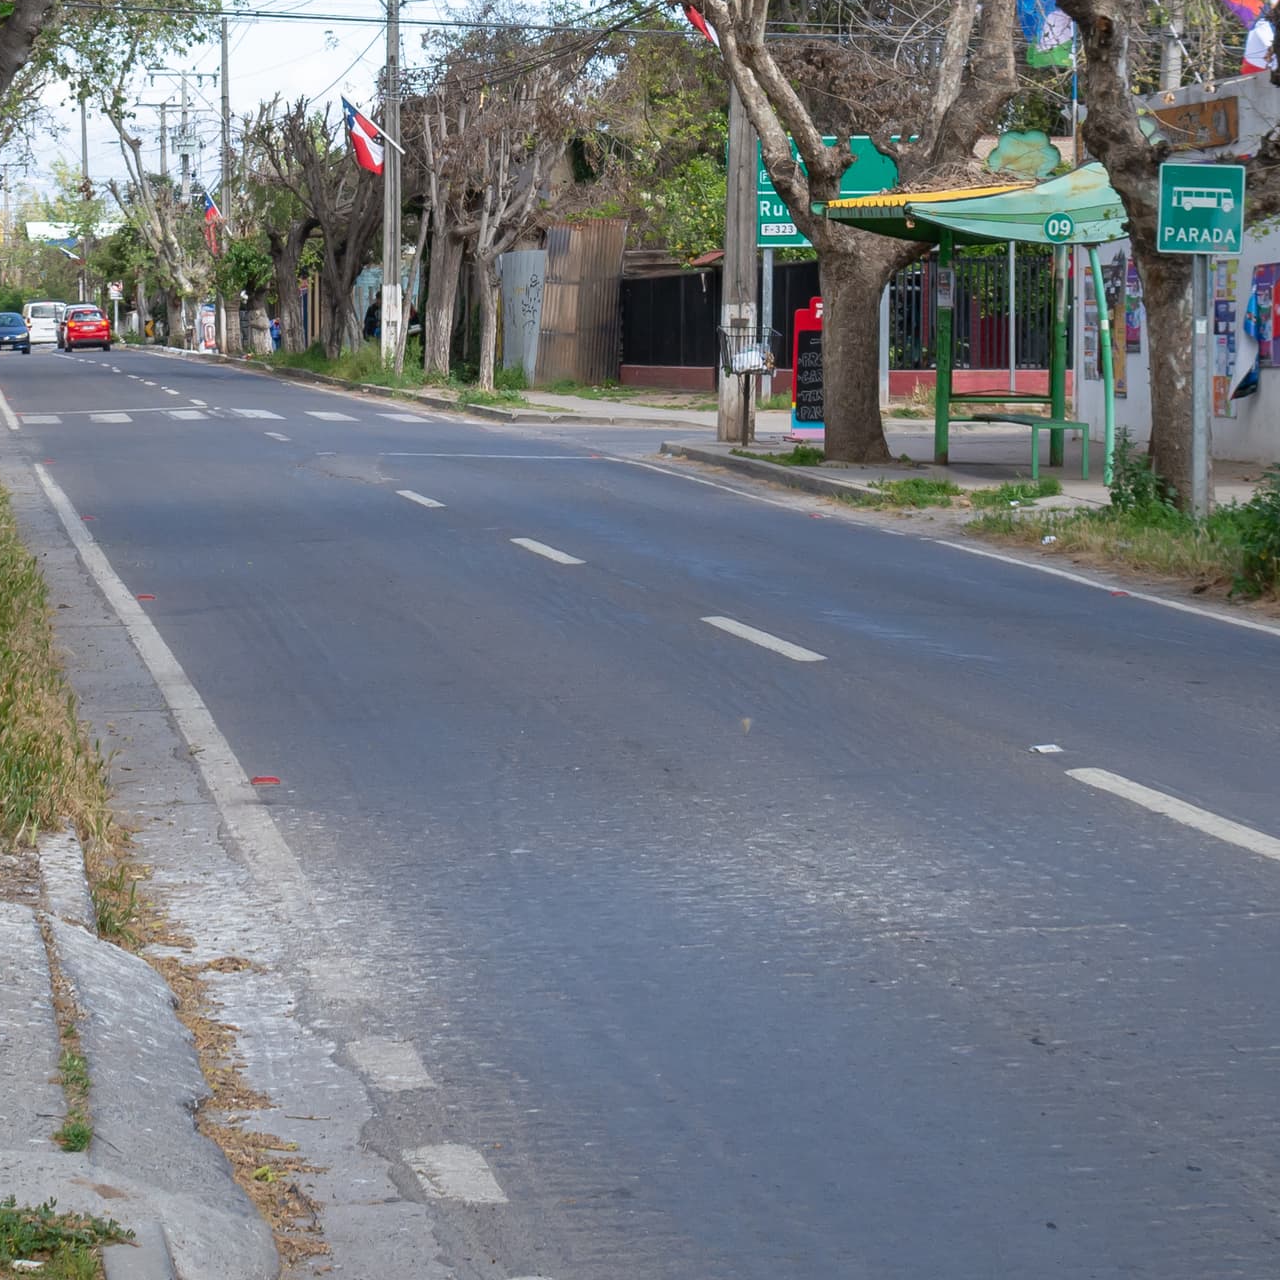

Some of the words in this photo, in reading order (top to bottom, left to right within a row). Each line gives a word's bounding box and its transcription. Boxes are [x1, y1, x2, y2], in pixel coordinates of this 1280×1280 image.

[764, 225, 794, 234] F-323
[1048, 220, 1070, 236] 09
[1164, 227, 1236, 244] PARADA
